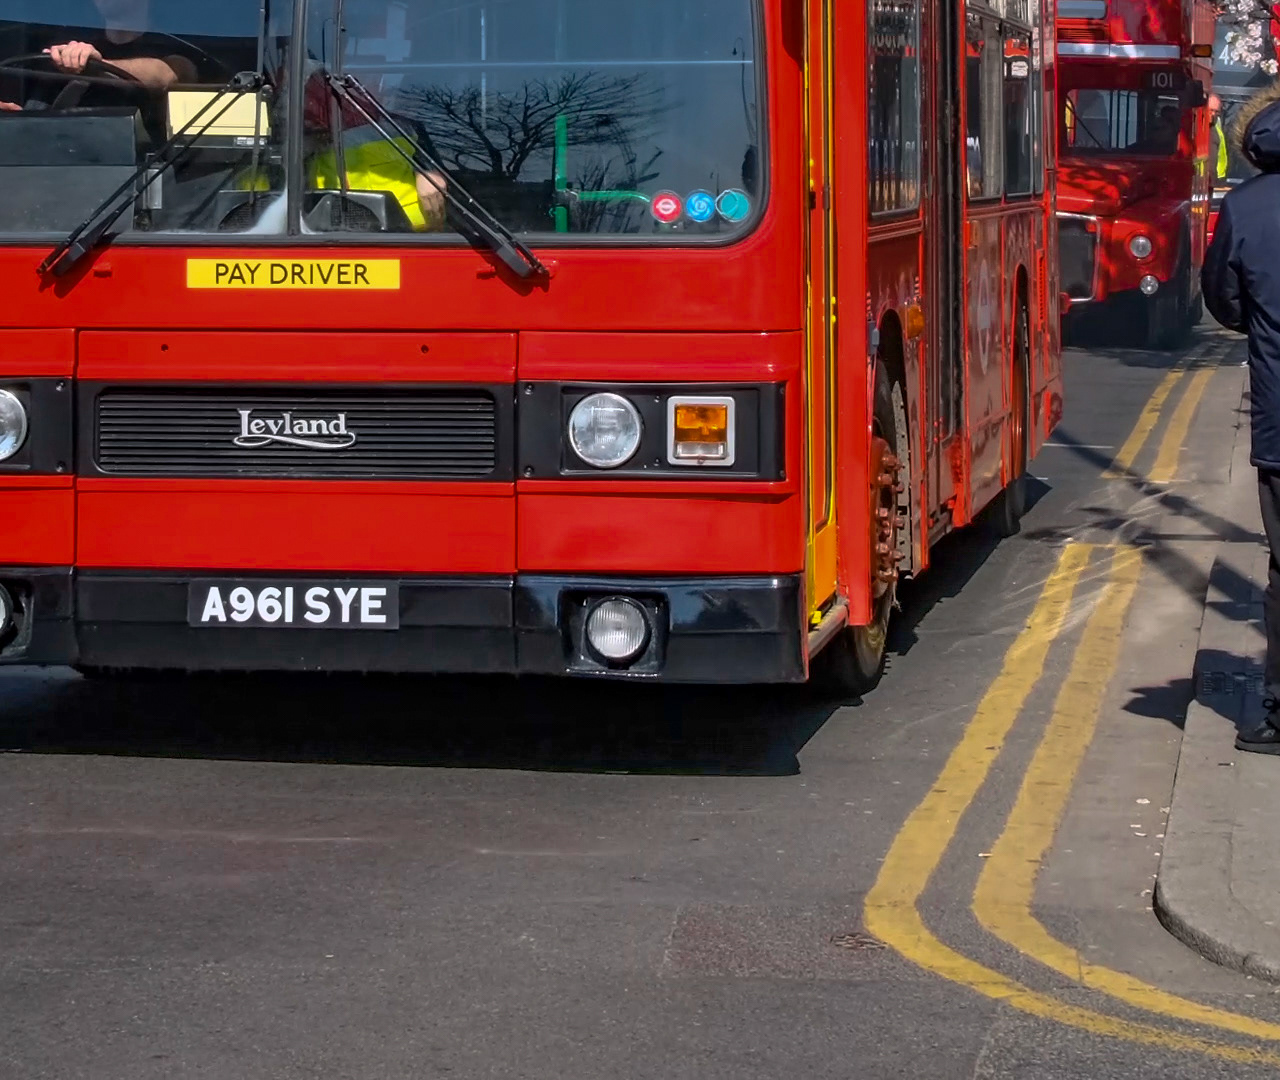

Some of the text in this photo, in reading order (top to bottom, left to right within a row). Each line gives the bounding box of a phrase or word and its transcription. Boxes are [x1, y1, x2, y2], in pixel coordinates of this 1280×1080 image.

[1152, 72, 1174, 88] 101
[215, 263, 370, 285] PAY DRIVER
[233, 407, 356, 448] Leyland
[201, 586, 387, 624] A961 SYE
